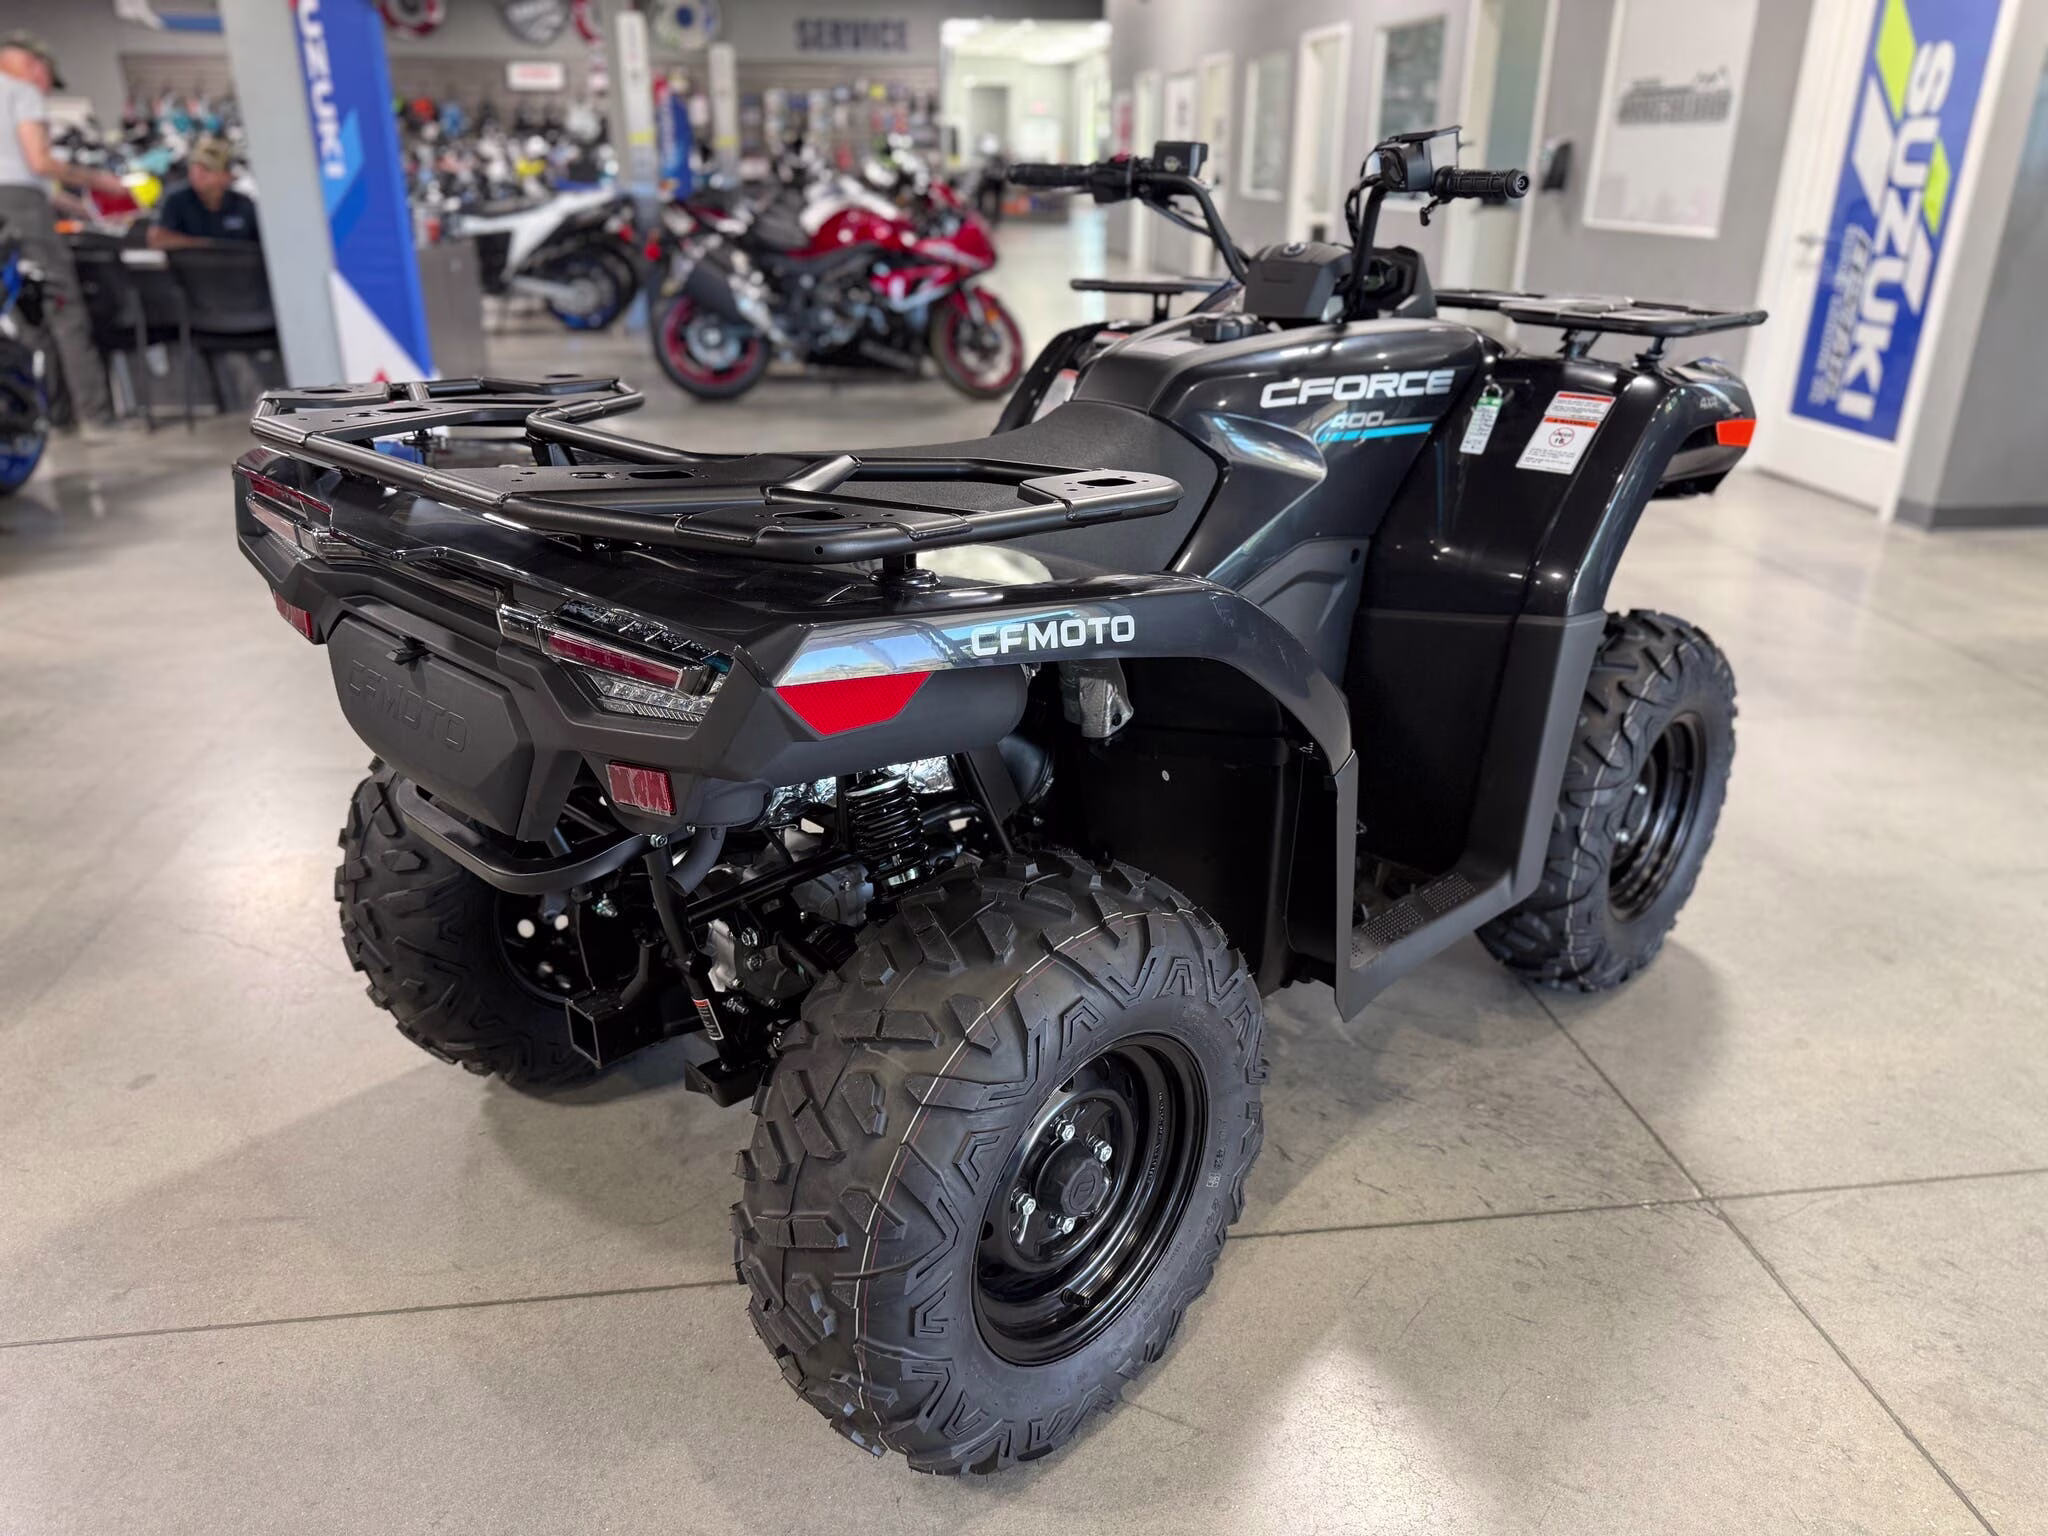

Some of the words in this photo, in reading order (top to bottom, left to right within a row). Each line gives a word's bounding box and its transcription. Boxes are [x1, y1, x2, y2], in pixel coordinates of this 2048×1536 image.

[796, 19, 906, 51] SERVICE
[1837, 41, 1955, 421] SUZUKI
[1260, 370, 1455, 408] CFORCE
[1330, 411, 1384, 429] 400
[971, 615, 1135, 656] CFMOTO
[348, 659, 470, 753] CFMOTO
